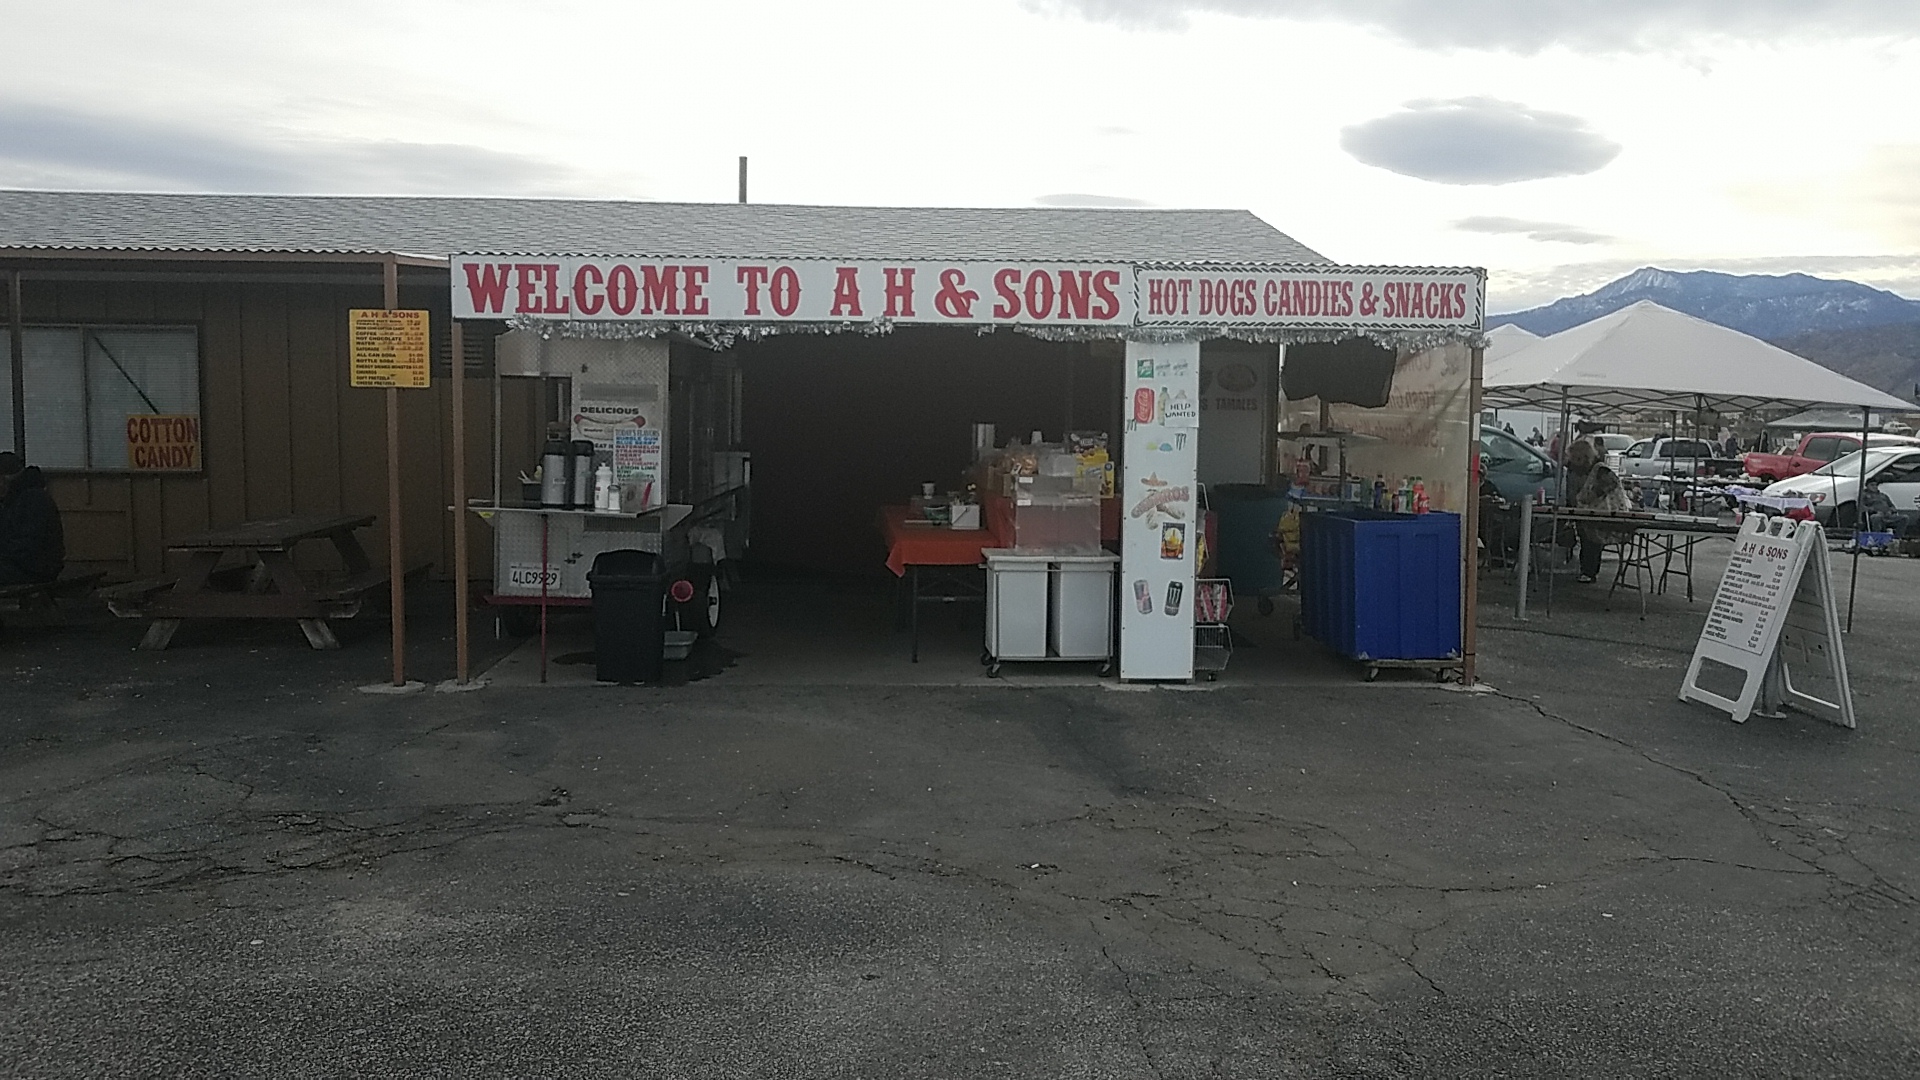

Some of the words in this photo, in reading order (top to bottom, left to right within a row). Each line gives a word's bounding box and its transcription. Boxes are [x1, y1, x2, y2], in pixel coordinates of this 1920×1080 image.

[462, 263, 709, 315] WELCOME
[737, 266, 802, 316] TO
[830, 267, 863, 316] A
[883, 268, 916, 316] H
[934, 268, 979, 318] &
[993, 269, 1120, 320] SONS
[1148, 279, 1192, 316] HOT
[1199, 279, 1257, 317] DOGS
[1263, 280, 1353, 317] CANDIES
[1359, 282, 1380, 315] &
[1383, 282, 1466, 319] SNACKS
[580, 406, 639, 415] DELICIOUS
[127, 418, 198, 443] COTTON
[135, 446, 194, 468] CANDY
[1742, 542, 1748, 552] A
[1749, 544, 1756, 553] H
[1758, 545, 1765, 556] &
[1766, 547, 1788, 559] SONS
